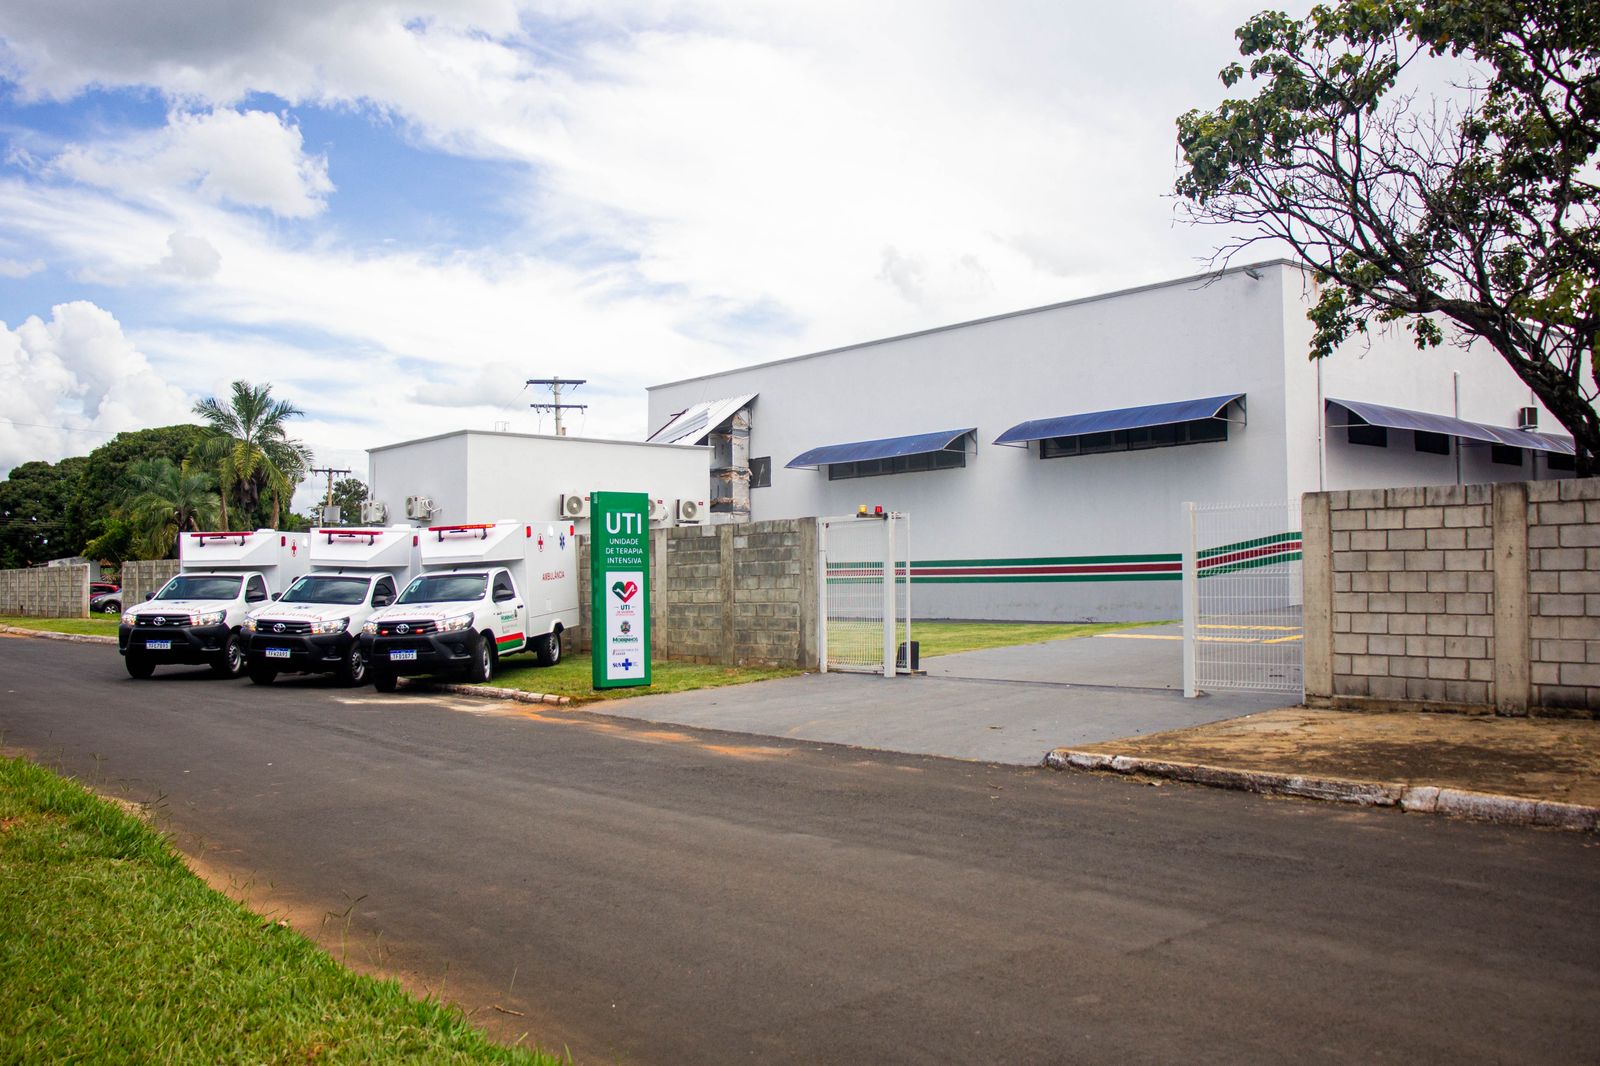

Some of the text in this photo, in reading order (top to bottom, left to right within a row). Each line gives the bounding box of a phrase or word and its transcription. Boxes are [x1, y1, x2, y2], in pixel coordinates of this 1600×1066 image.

[606, 512, 642, 535] UTI
[605, 547, 643, 555] DE TERAPIA
